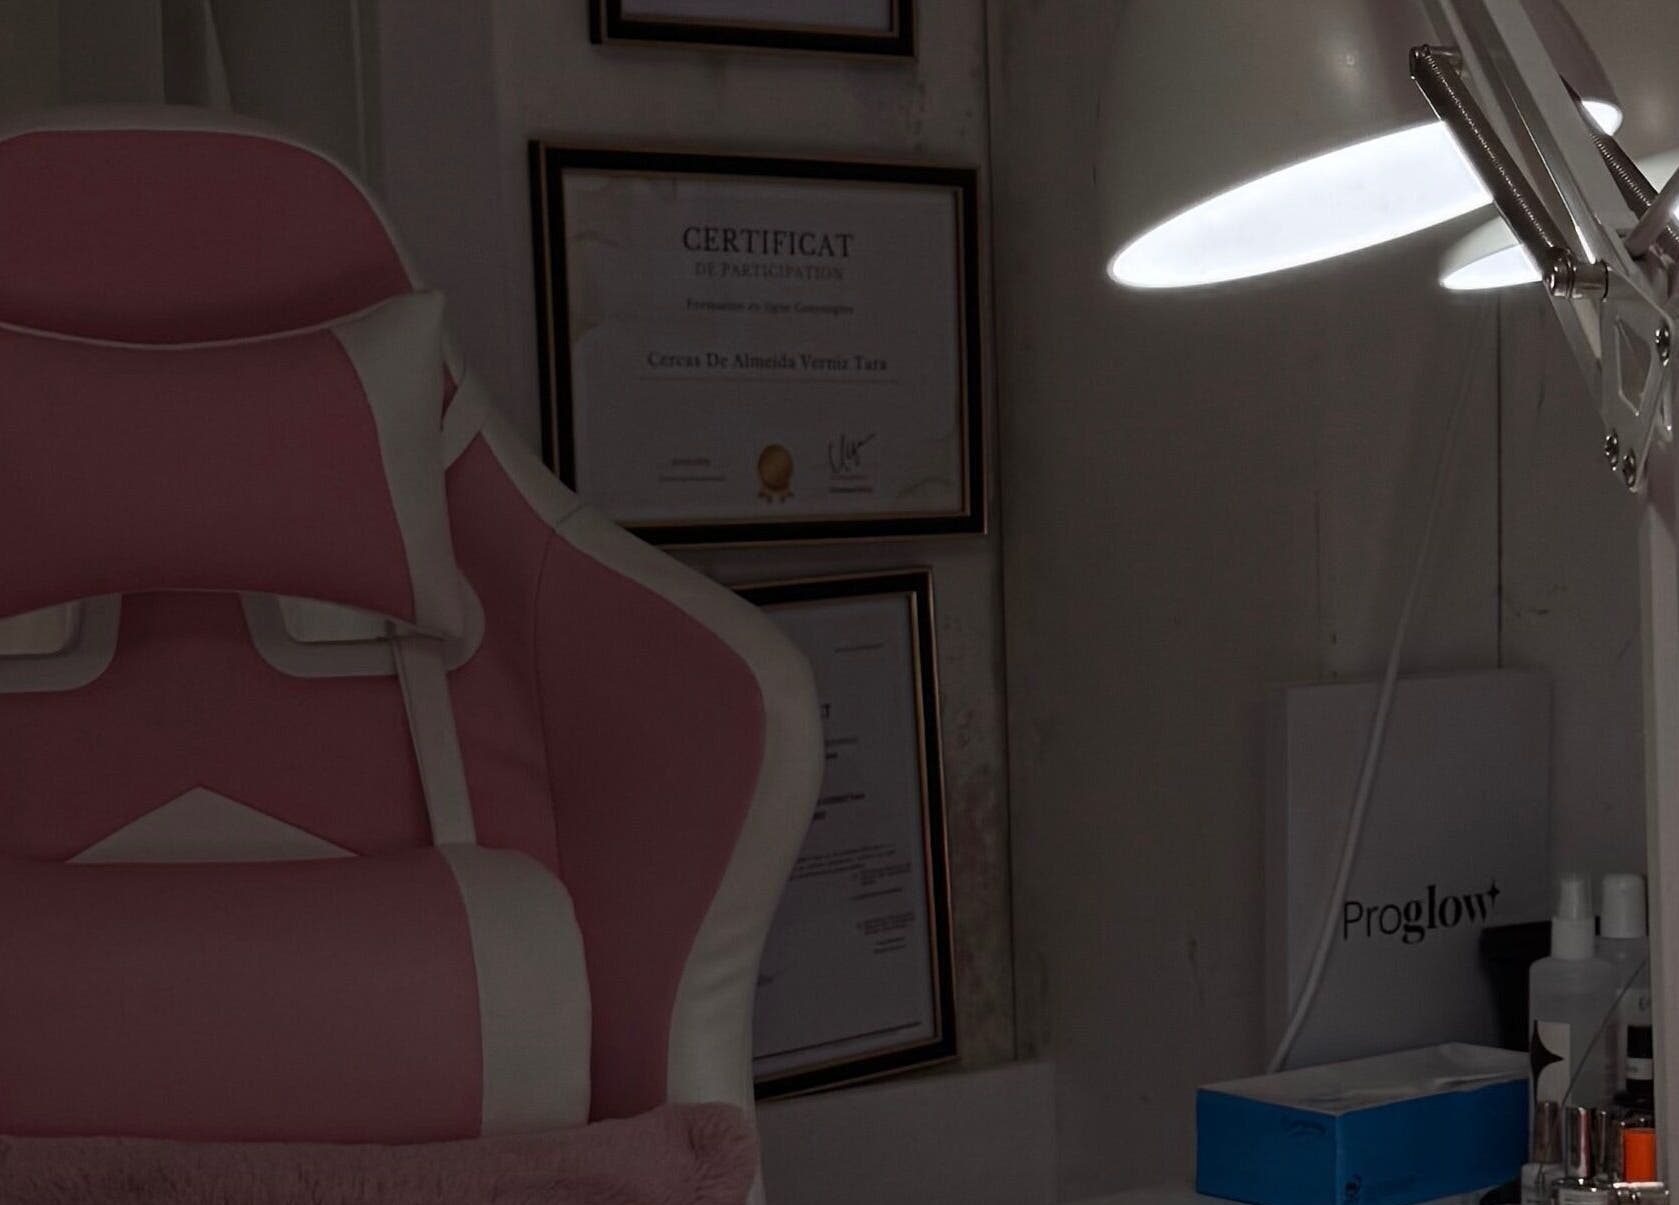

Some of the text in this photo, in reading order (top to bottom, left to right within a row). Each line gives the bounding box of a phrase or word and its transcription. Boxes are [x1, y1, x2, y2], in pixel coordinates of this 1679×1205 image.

[683, 226, 854, 258] CERTIFICAT
[695, 262, 845, 281] DE PARTICIPATION
[647, 352, 701, 369] Cercas
[706, 352, 729, 369] De
[734, 353, 796, 370] Almeida
[855, 354, 888, 371] Tara
